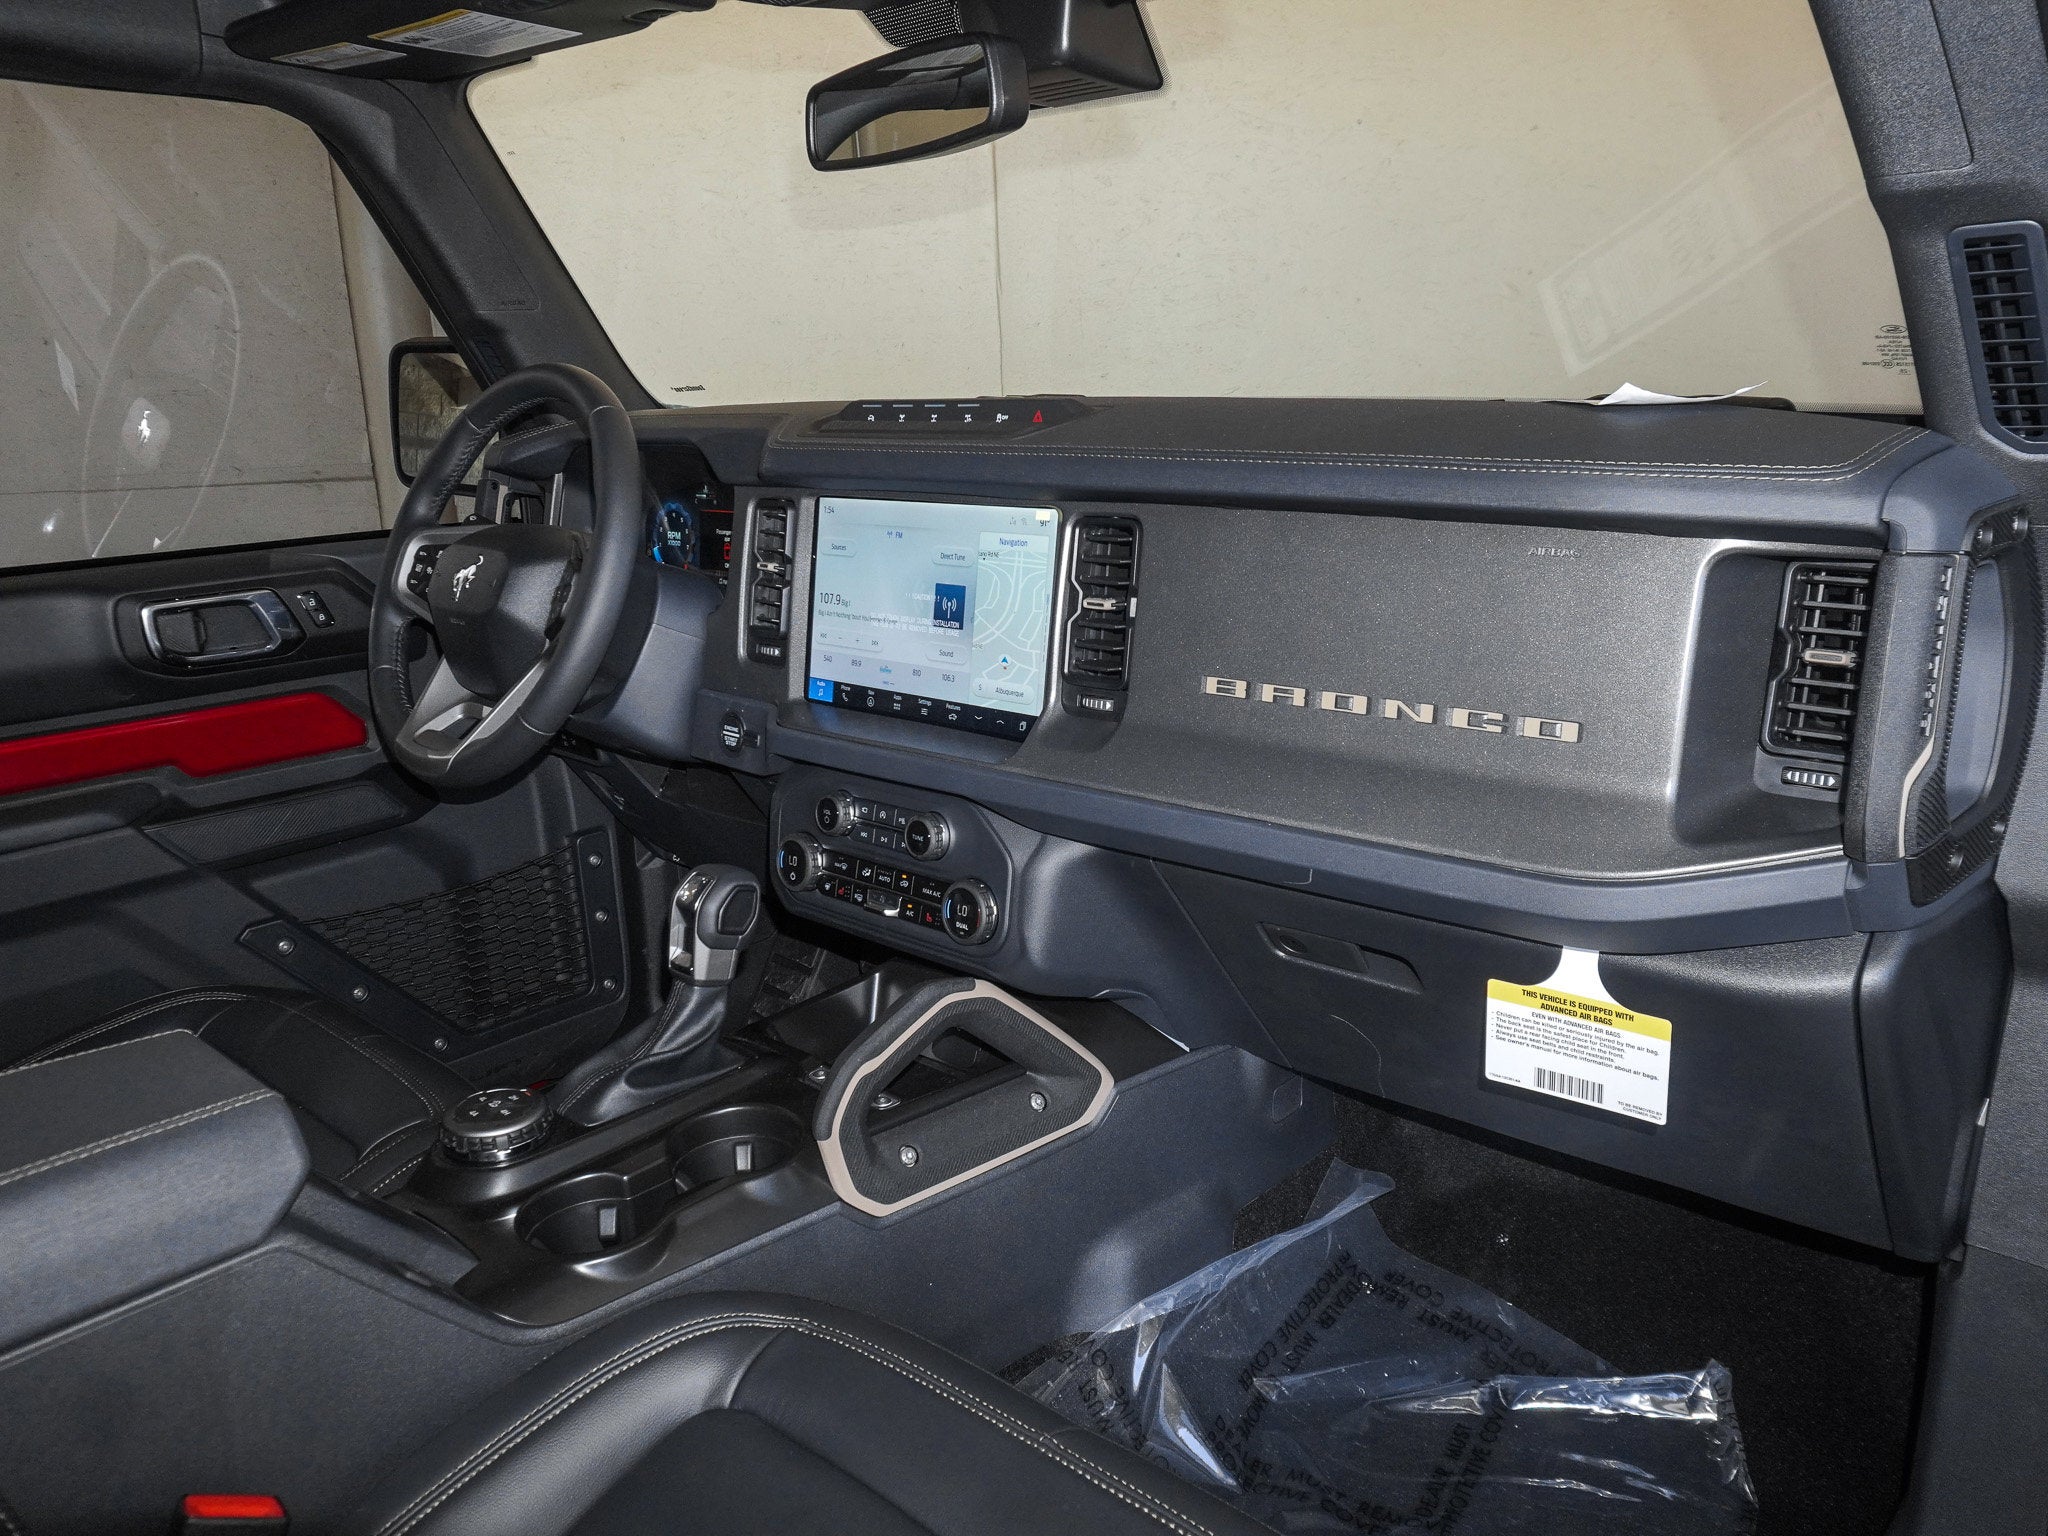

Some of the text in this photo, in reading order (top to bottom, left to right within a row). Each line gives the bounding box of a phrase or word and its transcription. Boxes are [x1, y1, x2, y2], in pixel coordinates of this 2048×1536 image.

[824, 506, 835, 514] 1:54
[667, 531, 682, 540] RPM
[895, 531, 903, 539] FM
[831, 543, 847, 551] Sources
[999, 537, 1029, 548] Navigation
[940, 552, 966, 562] Direct Tune
[1527, 545, 1582, 559] AIRBAG
[820, 592, 841, 606] 107.9
[934, 620, 960, 629] INSTALLATION
[823, 654, 833, 663] 540
[939, 649, 954, 658] Sound
[851, 658, 863, 668] 89.9
[912, 668, 922, 677] 810
[942, 673, 956, 683] 106.3
[995, 685, 1025, 699] Albuquerque
[1203, 675, 1581, 744] BRONCO
[724, 725, 739, 733] ENGINE
[912, 833, 924, 843] TUNE
[788, 854, 798, 867] LO
[879, 874, 891, 884] AUTO
[922, 887, 942, 899] MAX A/C
[906, 909, 915, 918] A/C
[957, 904, 968, 917] LO
[956, 921, 969, 931] DUAL
[1522, 989, 1635, 1022] THIS VEHICLE IS EQUIPPED WITH
[1540, 1003, 1613, 1026] ADVANCED AIR BAGS
[1532, 1012, 1546, 1020] EVEN
[1548, 1016, 1562, 1024] WITH
[1563, 1020, 1593, 1032] ADVANCED
[1594, 1027, 1604, 1035] AIR
[1496, 1011, 1521, 1021] Children
[1542, 1022, 1558, 1030] killed
[1566, 1028, 1593, 1040] seriously
[1594, 1035, 1616, 1046] injured
[1617, 1040, 1625, 1048] by
[1626, 1042, 1636, 1050] the
[1508, 1020, 1521, 1028] back
[1554, 1031, 1571, 1040] safest
[1572, 1035, 1589, 1044] place
[1496, 1023, 1513, 1031] Never
[1542, 1034, 1560, 1044] facing
[1561, 1039, 1576, 1047] child
[1597, 1047, 1608, 1055] the
[1496, 1029, 1517, 1039] Always
[1559, 1044, 1569, 1052] and
[1570, 1047, 1585, 1055] child
[1508, 1038, 1530, 1048] owner's
[1531, 1044, 1553, 1053] manual
[1563, 1052, 1578, 1060] more
[1579, 1055, 1613, 1069] information
[1614, 1065, 1632, 1074] about
[1633, 1069, 1641, 1077] air
[1383, 1268, 1445, 1307] COVER
[1275, 1261, 1345, 1343] PROTECTIVE
[1281, 1330, 1320, 1374] MUST
[1079, 1379, 1115, 1433] MUST
